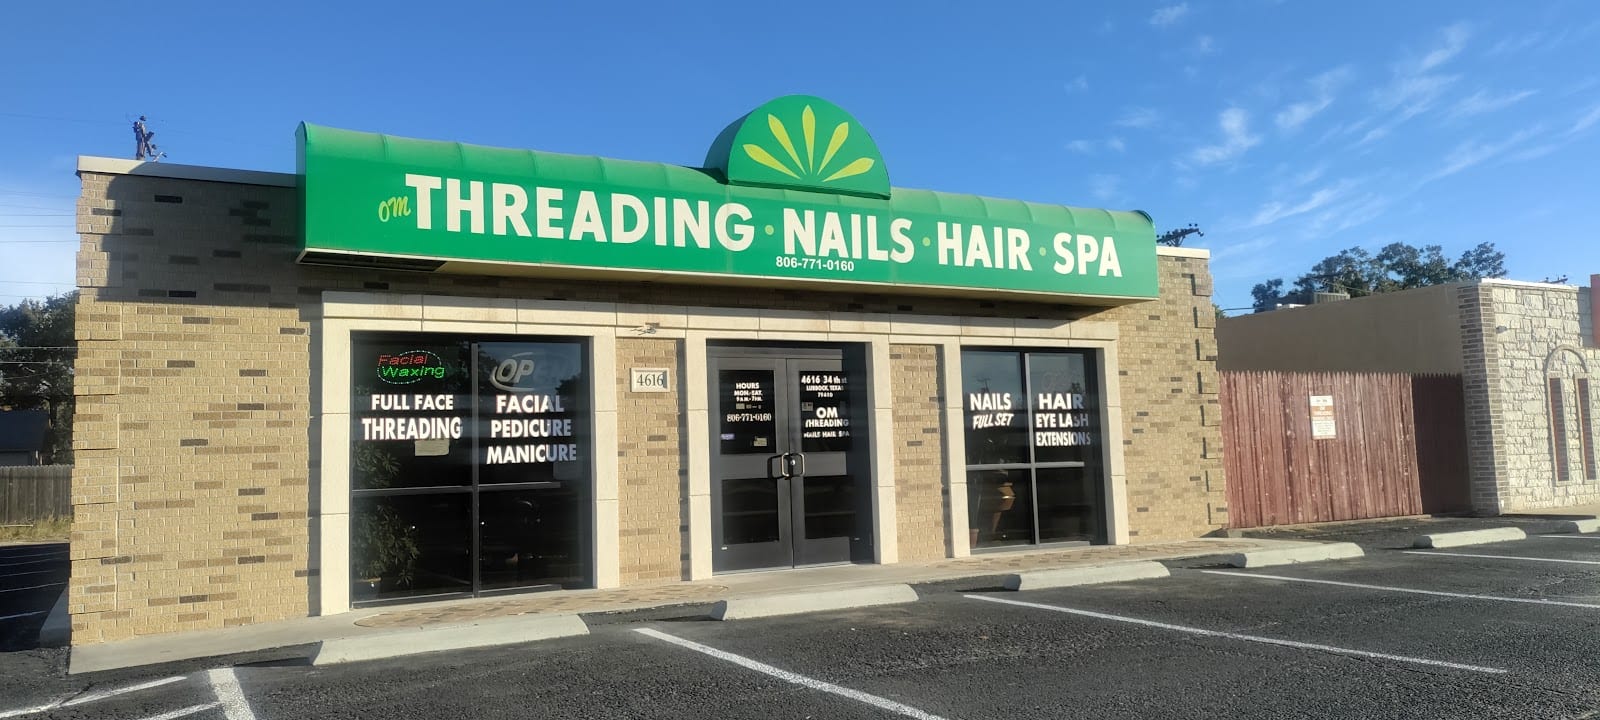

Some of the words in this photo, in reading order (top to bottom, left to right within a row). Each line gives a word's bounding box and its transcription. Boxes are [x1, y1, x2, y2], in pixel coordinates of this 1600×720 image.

[405, 173, 755, 252] THREADING
[783, 208, 915, 264] NAILS
[937, 221, 1033, 271] HAIR
[1053, 232, 1123, 278] SPA
[775, 256, 855, 272] 806-771-0160
[377, 353, 428, 367] Facial
[381, 365, 445, 379] Waxing
[636, 373, 664, 387] 4616
[801, 375, 820, 384] 4616
[735, 382, 760, 390] HOURS
[371, 394, 410, 411] FULL
[414, 394, 454, 410] FACE
[495, 395, 565, 414] FACIAL
[970, 392, 1012, 411] NAILS
[1038, 393, 1084, 410] HAIR
[726, 413, 772, 422] 806-771-0160
[816, 407, 838, 418] OM
[1035, 413, 1057, 428] EYE
[362, 417, 463, 440] THREADING
[490, 419, 572, 438] PEDICURE
[973, 414, 994, 430] FULL
[995, 413, 1014, 427] SET
[1035, 431, 1091, 447] EXTENSIONS
[486, 444, 577, 465] MANICURE
